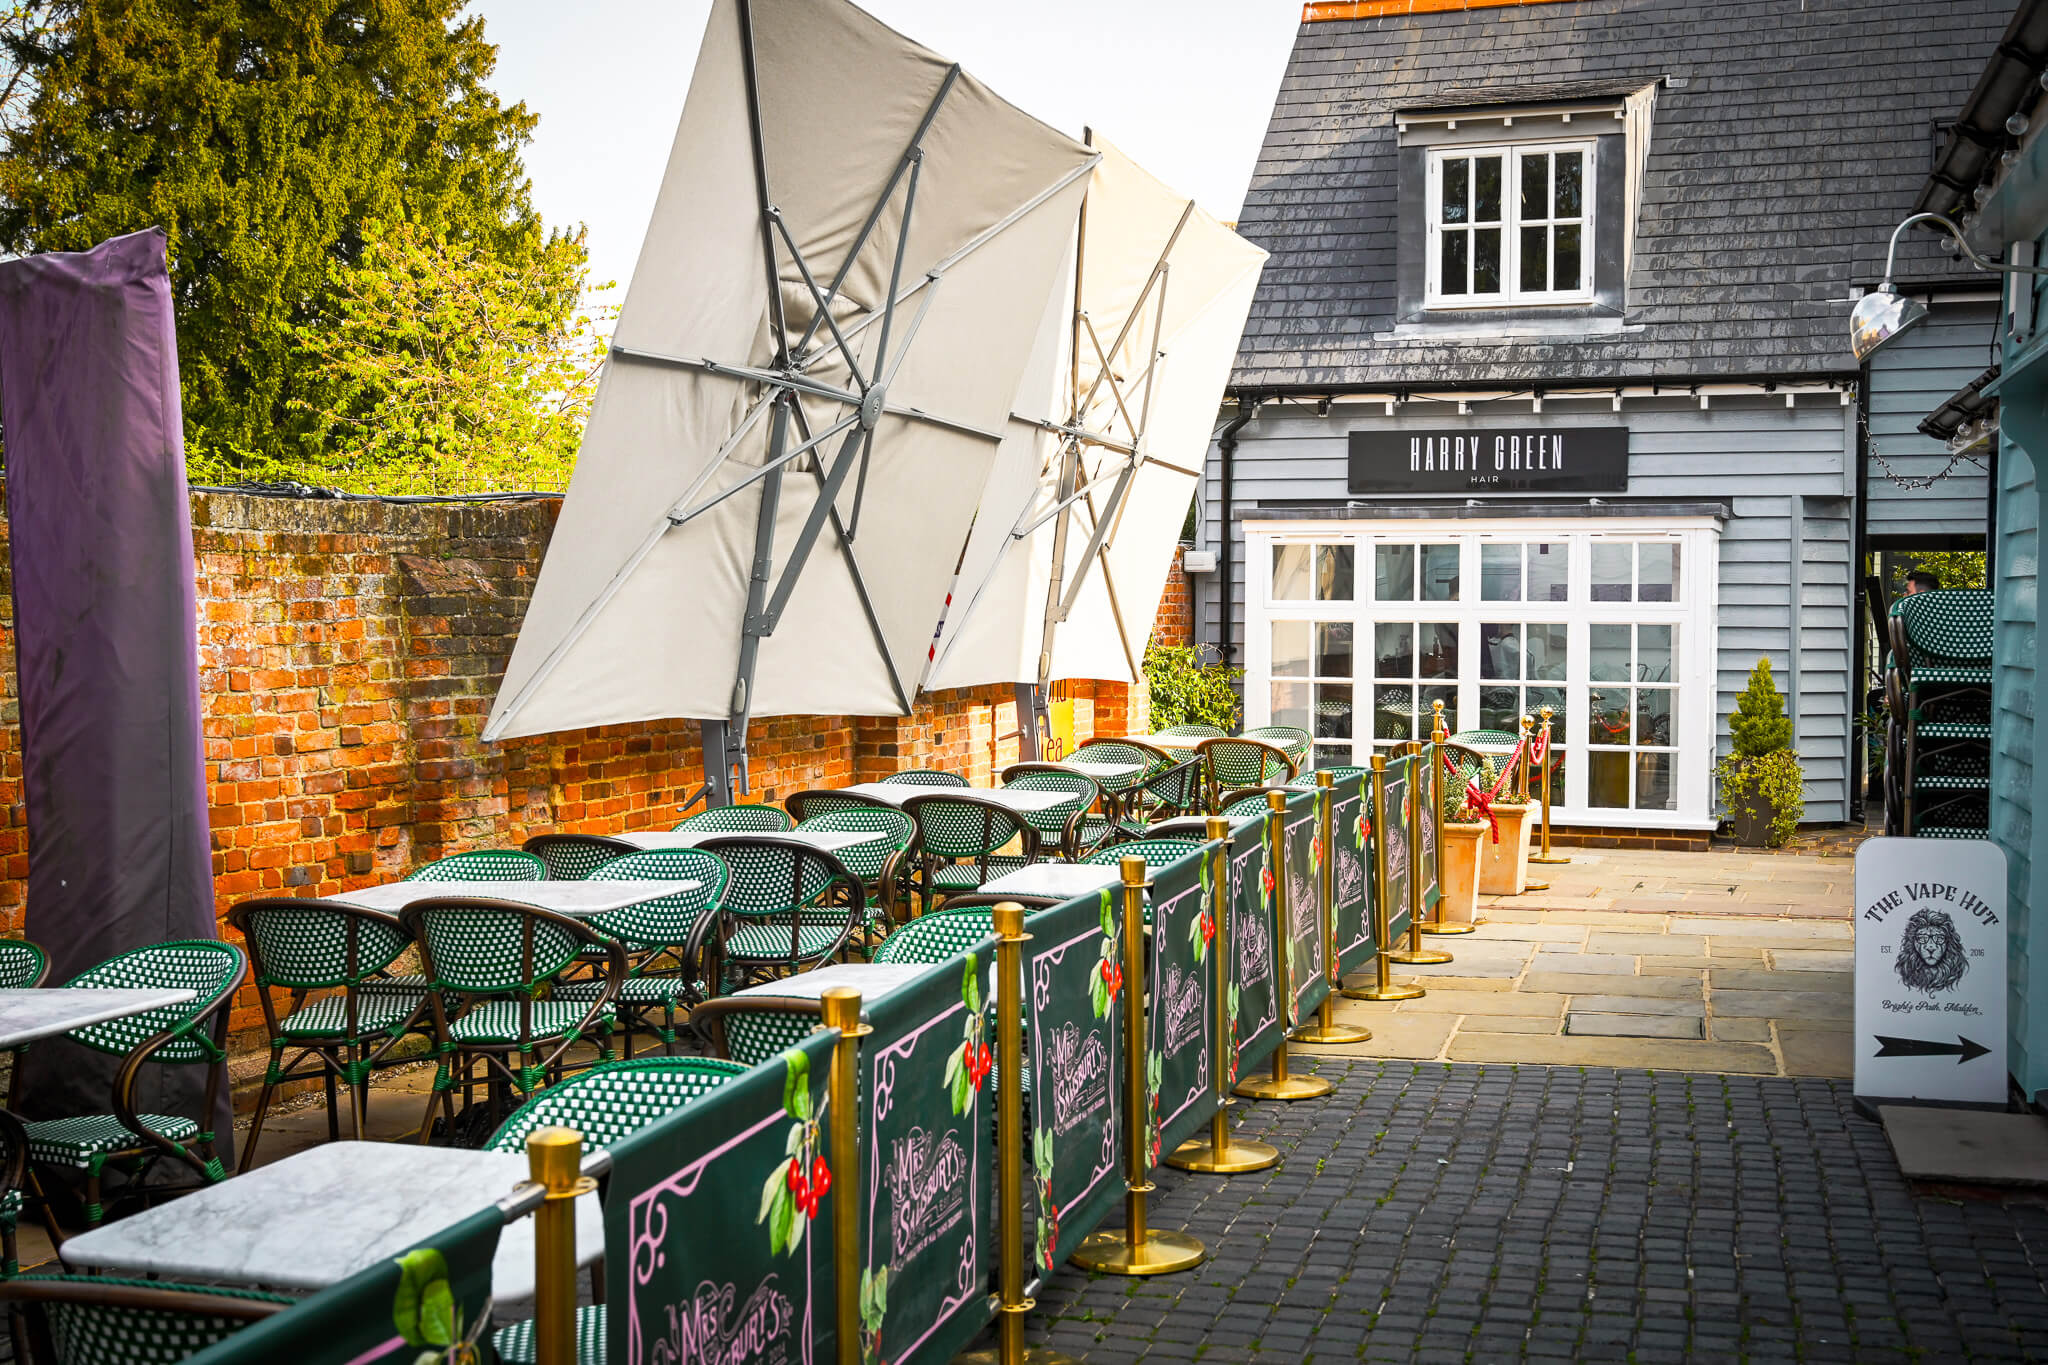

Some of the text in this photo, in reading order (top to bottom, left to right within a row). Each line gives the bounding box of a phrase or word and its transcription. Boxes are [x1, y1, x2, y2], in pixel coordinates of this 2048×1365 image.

[1410, 434, 1563, 472] HARRY GREEN
[1471, 475, 1500, 484] HAIR
[1863, 882, 2000, 926] THE VAPE HUT
[1970, 948, 1985, 957] 2016
